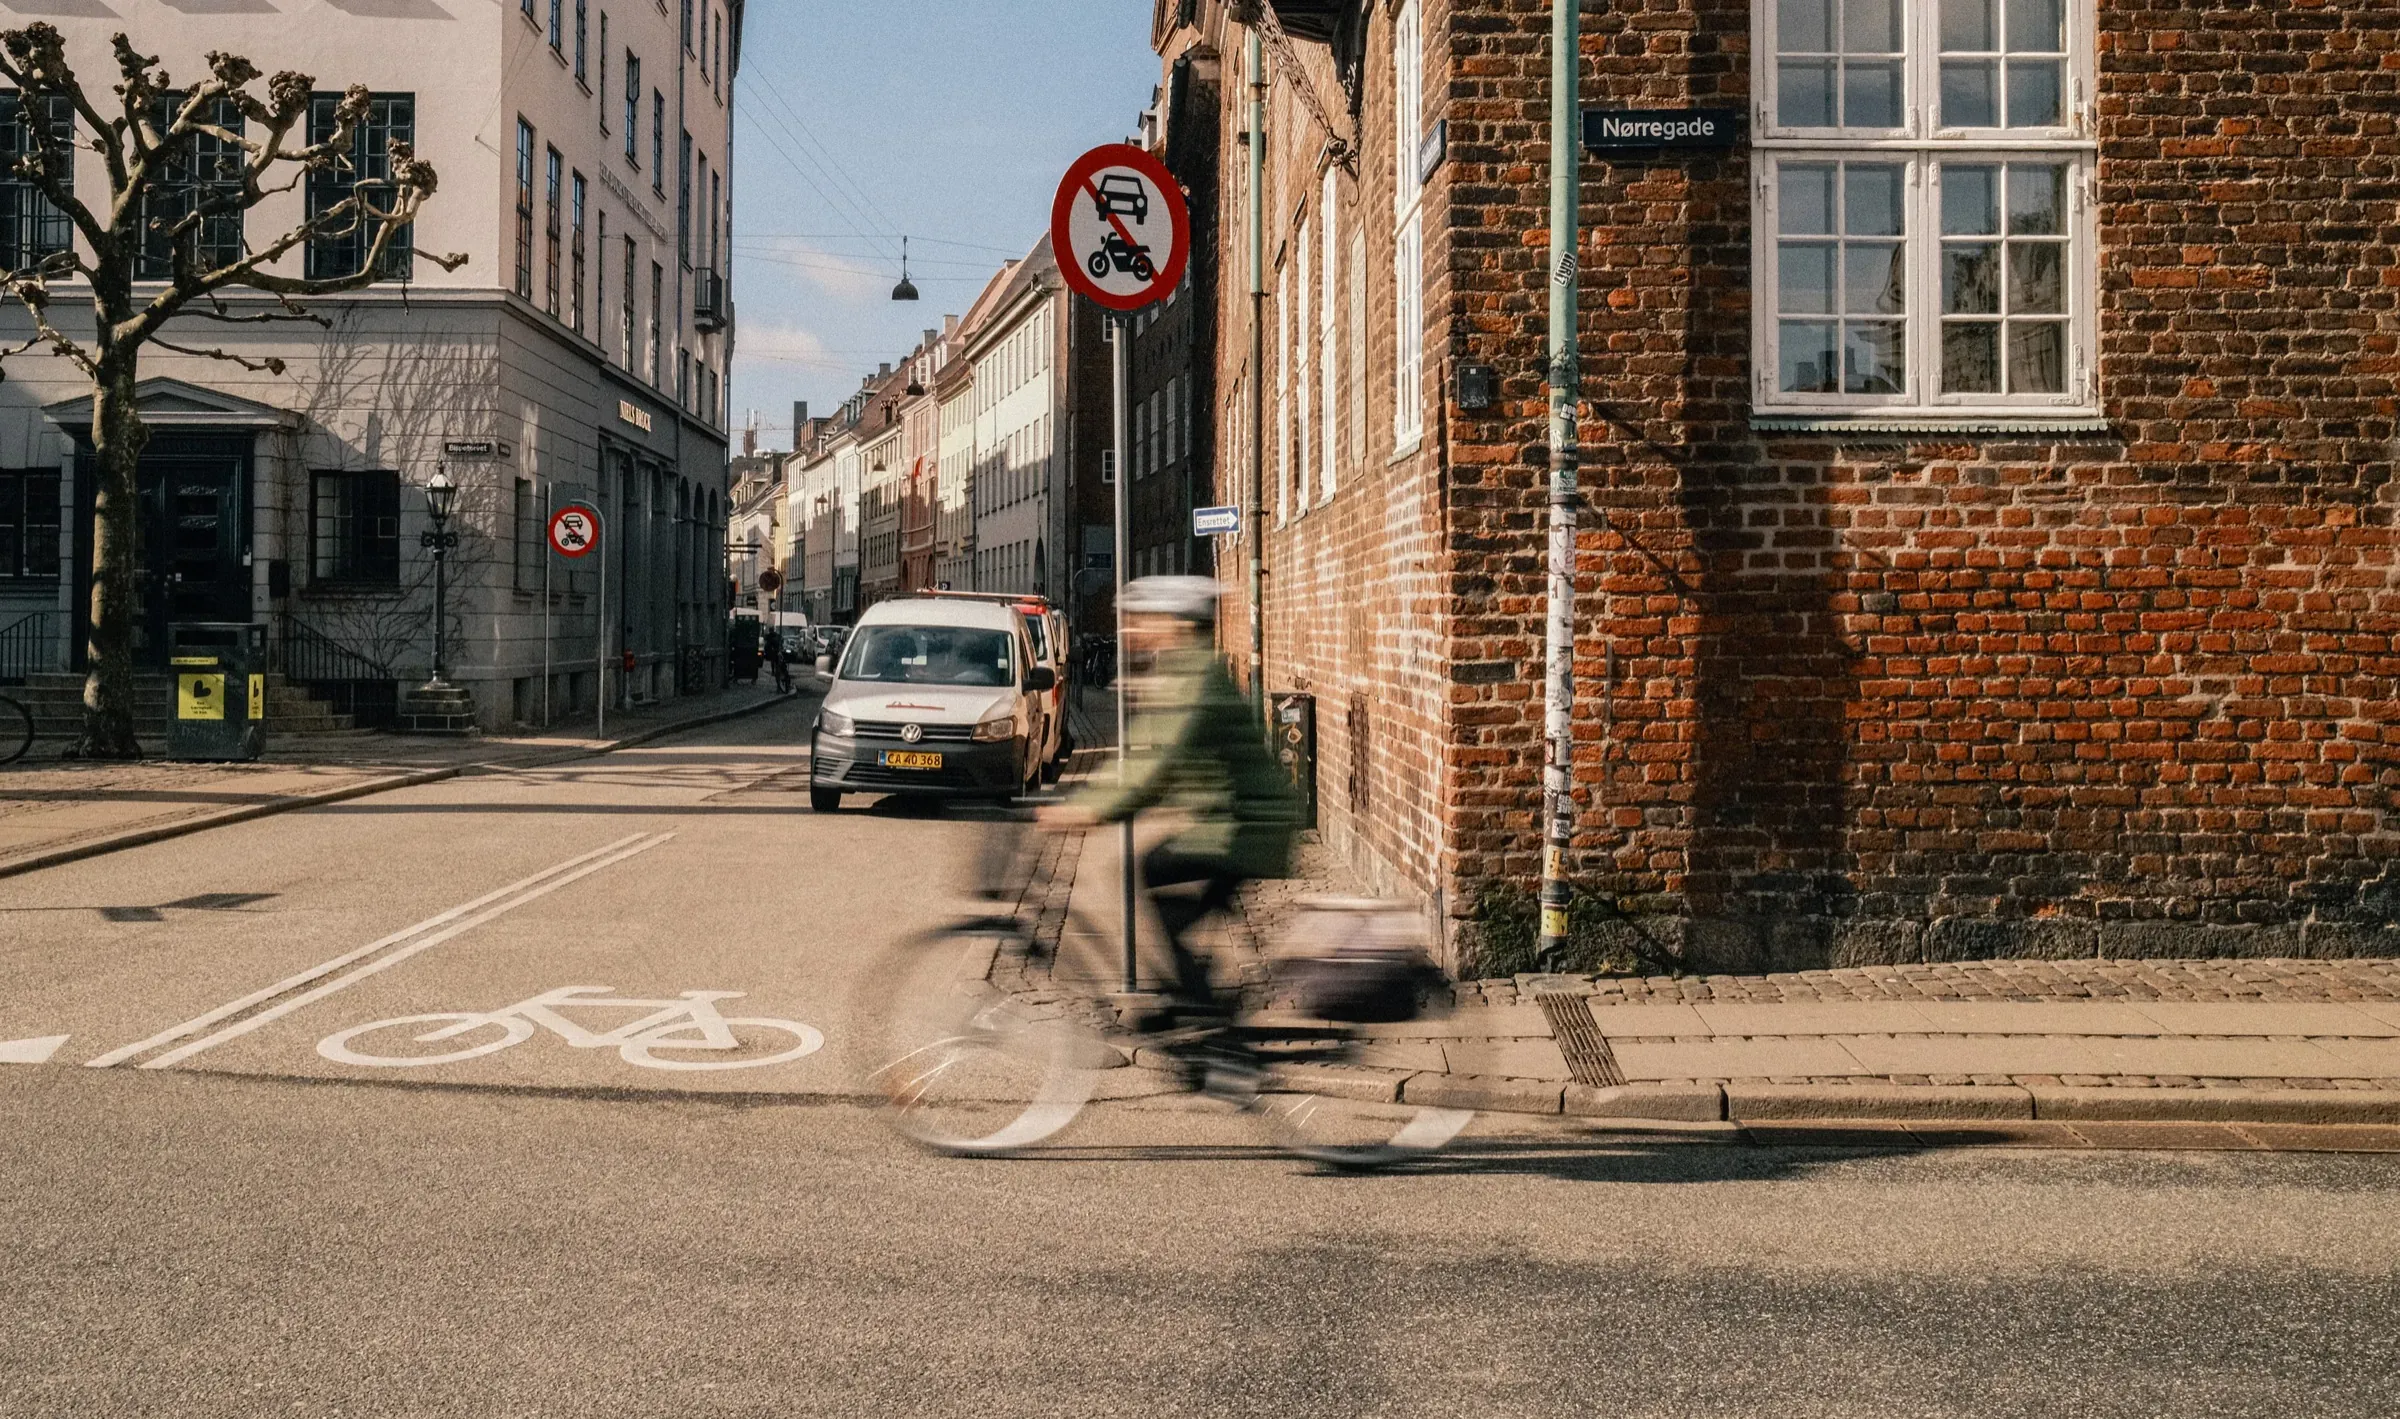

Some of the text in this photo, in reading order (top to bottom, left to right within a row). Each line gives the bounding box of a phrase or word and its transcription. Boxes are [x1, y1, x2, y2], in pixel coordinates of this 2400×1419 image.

[1602, 116, 1715, 141] Nørregade
[1197, 516, 1231, 527] Ensrettet
[887, 753, 940, 766] CA 40 368
